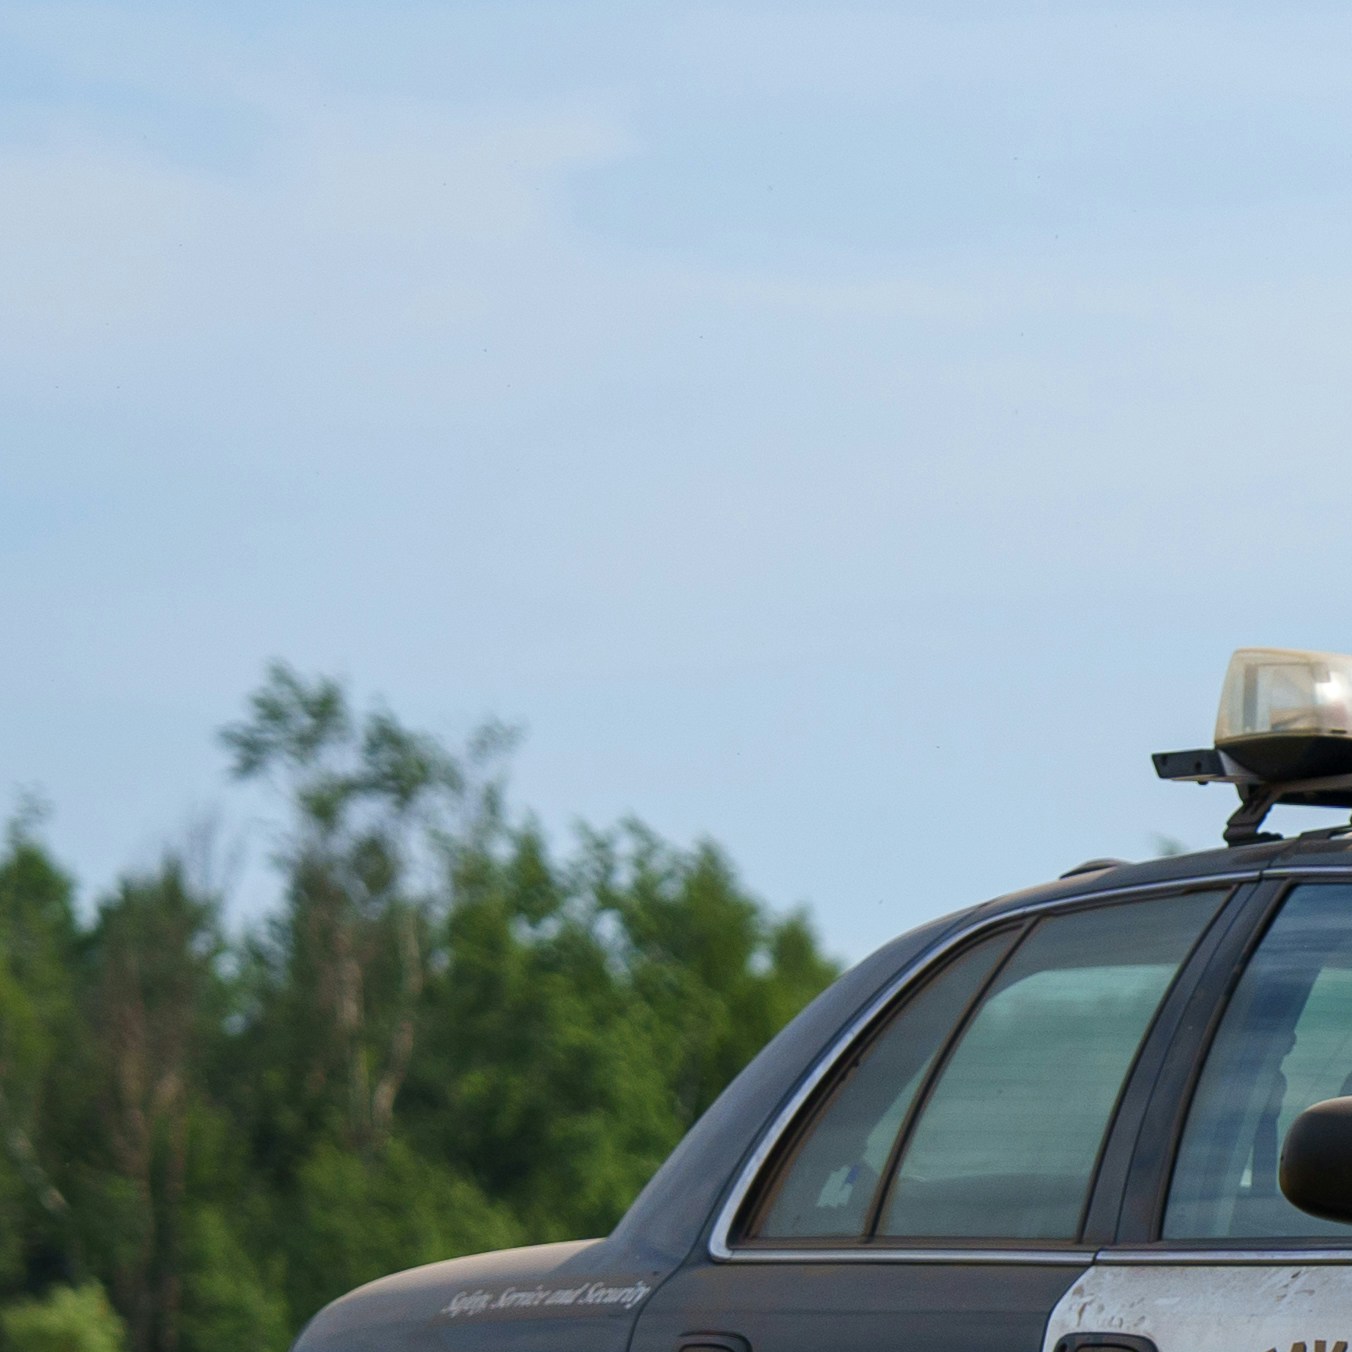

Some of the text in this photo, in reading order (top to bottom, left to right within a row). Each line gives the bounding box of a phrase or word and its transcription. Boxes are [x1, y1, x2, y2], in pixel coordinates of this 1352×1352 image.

[490, 1286, 552, 1309] Service
[545, 1282, 590, 1305] and
[577, 1281, 651, 1309] Security
